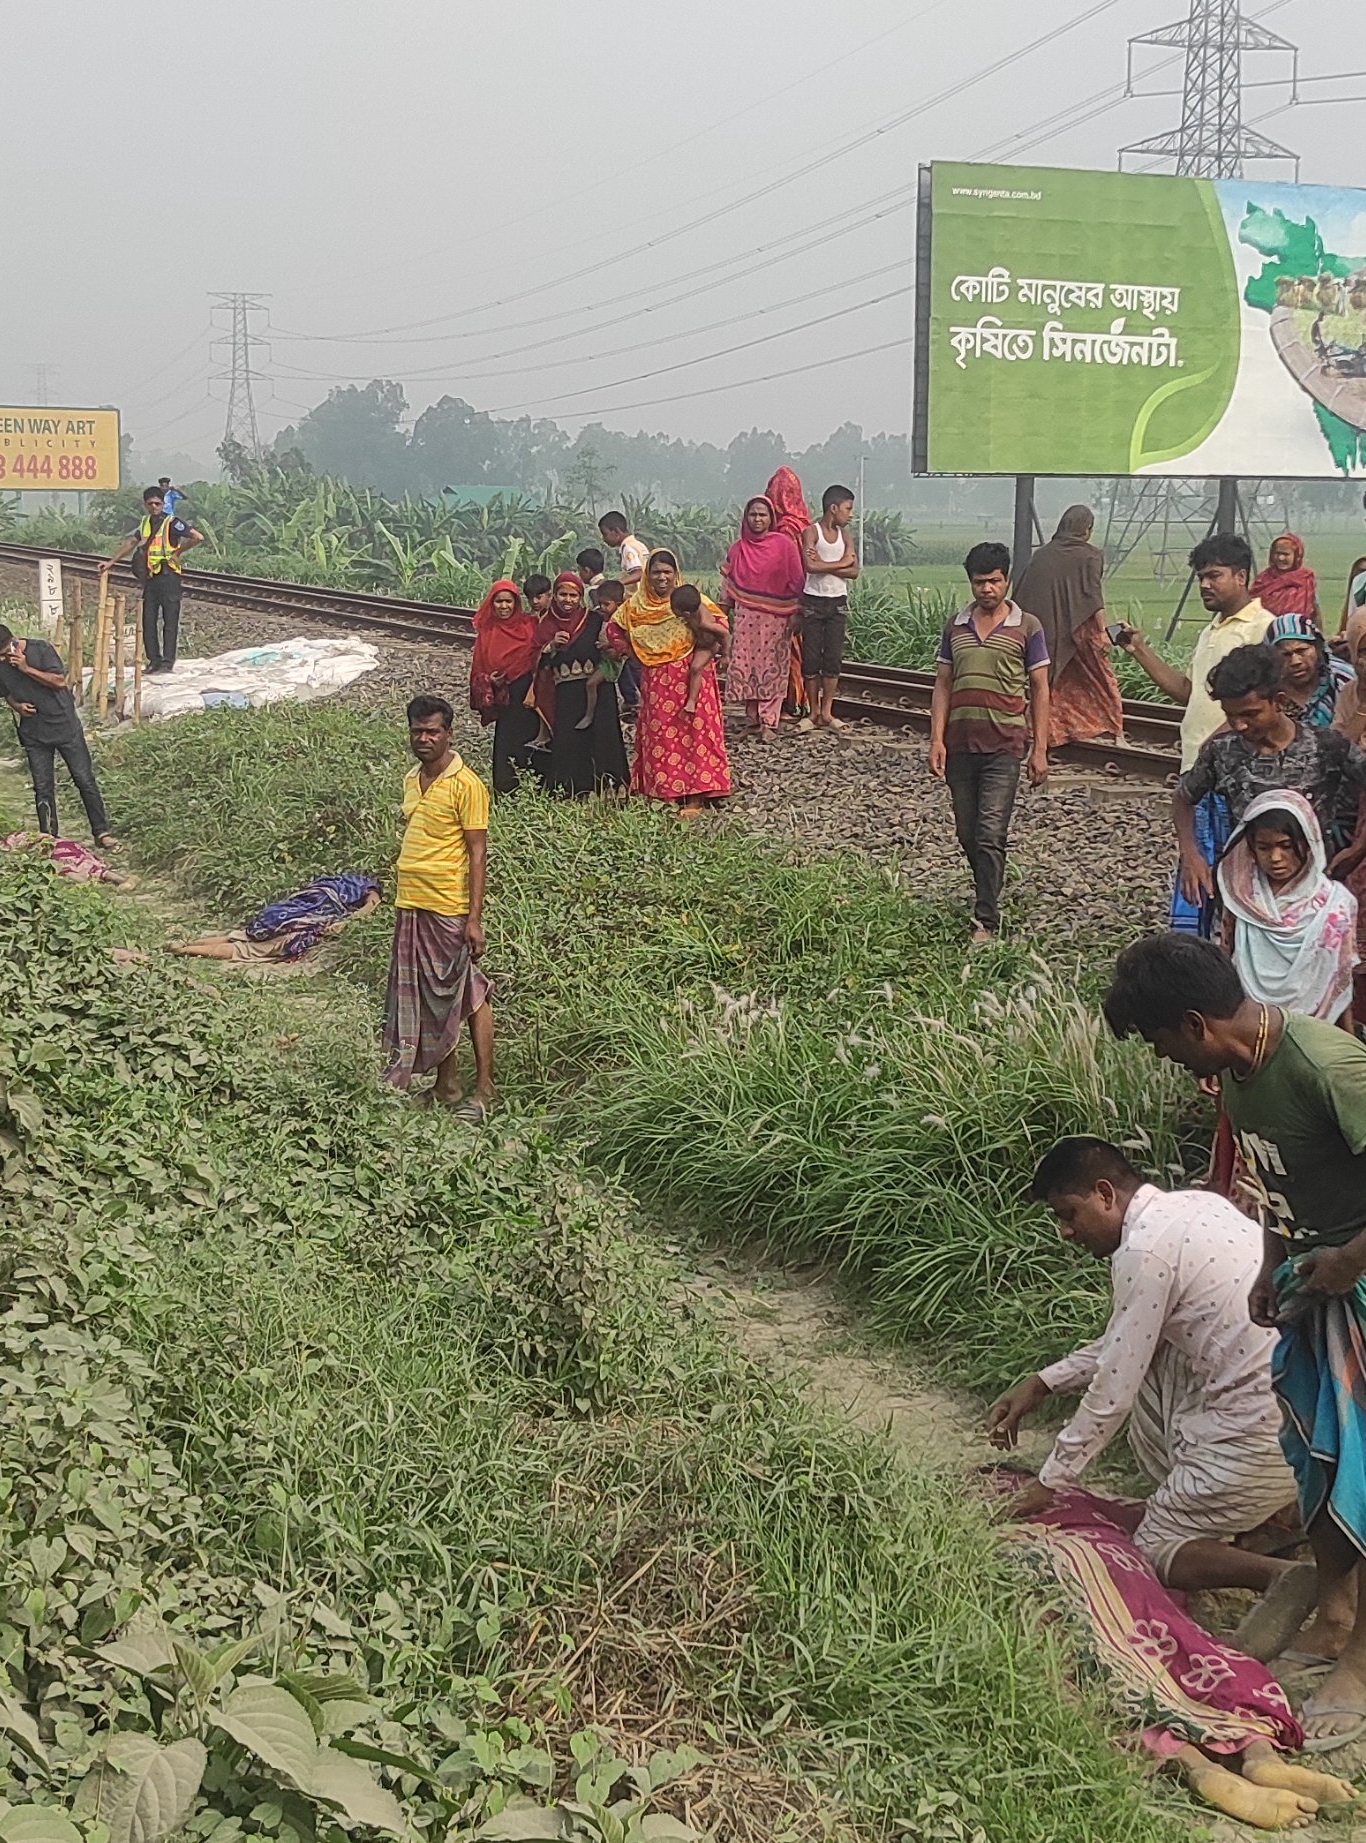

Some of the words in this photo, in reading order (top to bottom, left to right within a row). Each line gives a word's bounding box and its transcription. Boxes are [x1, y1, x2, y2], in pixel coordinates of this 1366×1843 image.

[951, 187, 1042, 201] www.syngenta.com.bd
[951, 266, 1011, 304] কোটি
[1016, 278, 1105, 316] মানুষের
[949, 315, 1037, 370] কৃষিতে
[28, 418, 61, 435] WAY
[65, 420, 96, 436] ART
[12, 454, 53, 480] 444
[58, 454, 97, 480] 888
